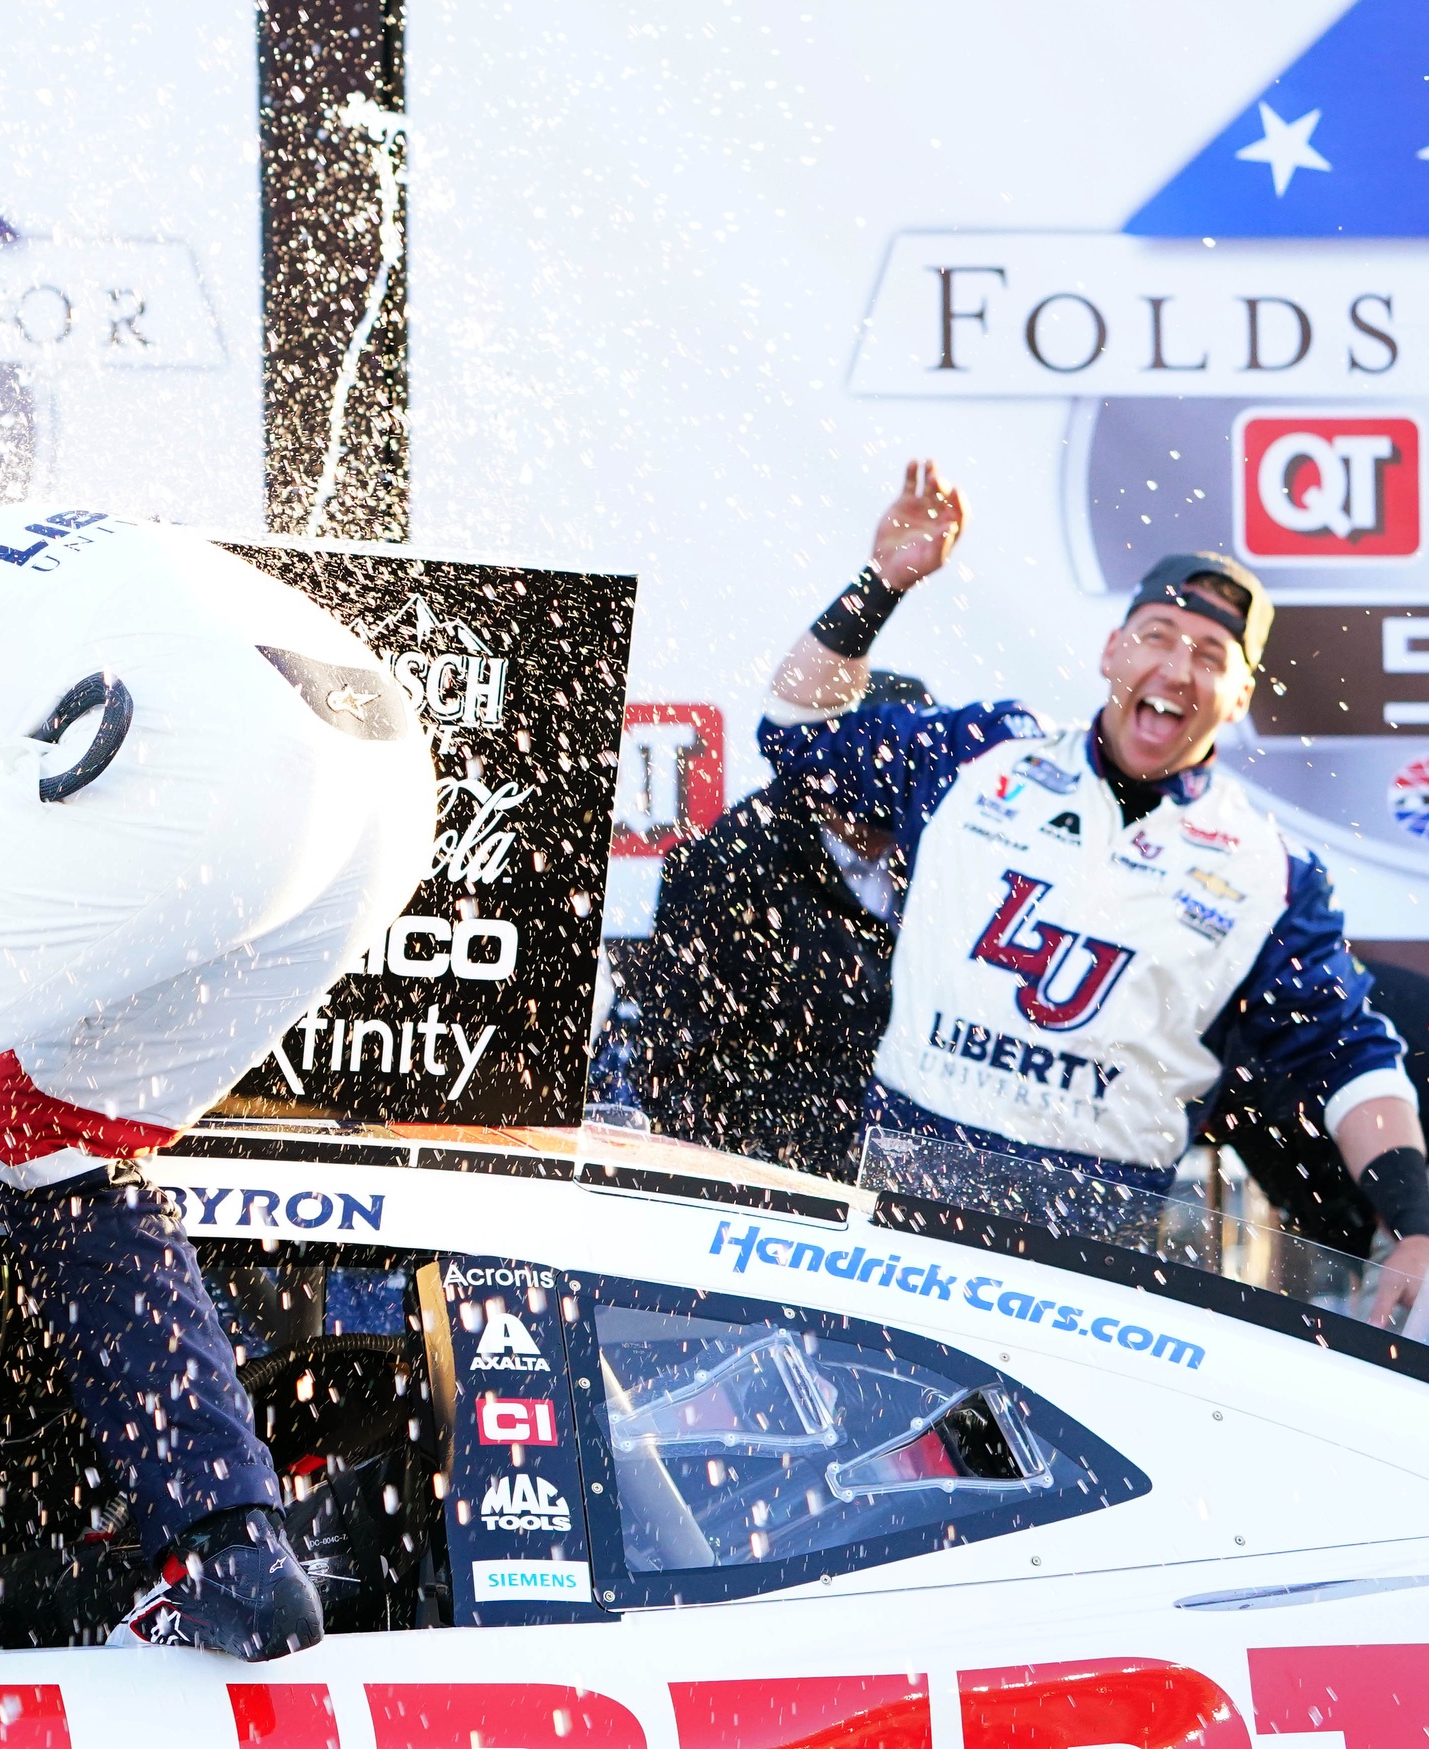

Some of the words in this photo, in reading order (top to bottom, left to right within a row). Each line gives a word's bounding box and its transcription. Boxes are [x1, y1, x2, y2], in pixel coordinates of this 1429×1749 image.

[924, 266, 1400, 374] FOLDS
[1258, 432, 1395, 540] QT
[391, 650, 509, 730] SCH
[968, 868, 1137, 1033] LU
[929, 1012, 1125, 1099] LIBERTY
[443, 1264, 556, 1289] Acronis
[470, 1357, 551, 1371] AXALTA
[482, 1402, 552, 1441] CI
[481, 1474, 570, 1515] MAC
[481, 1515, 572, 1532] TOOLS
[488, 1573, 577, 1588] SIEMENS
